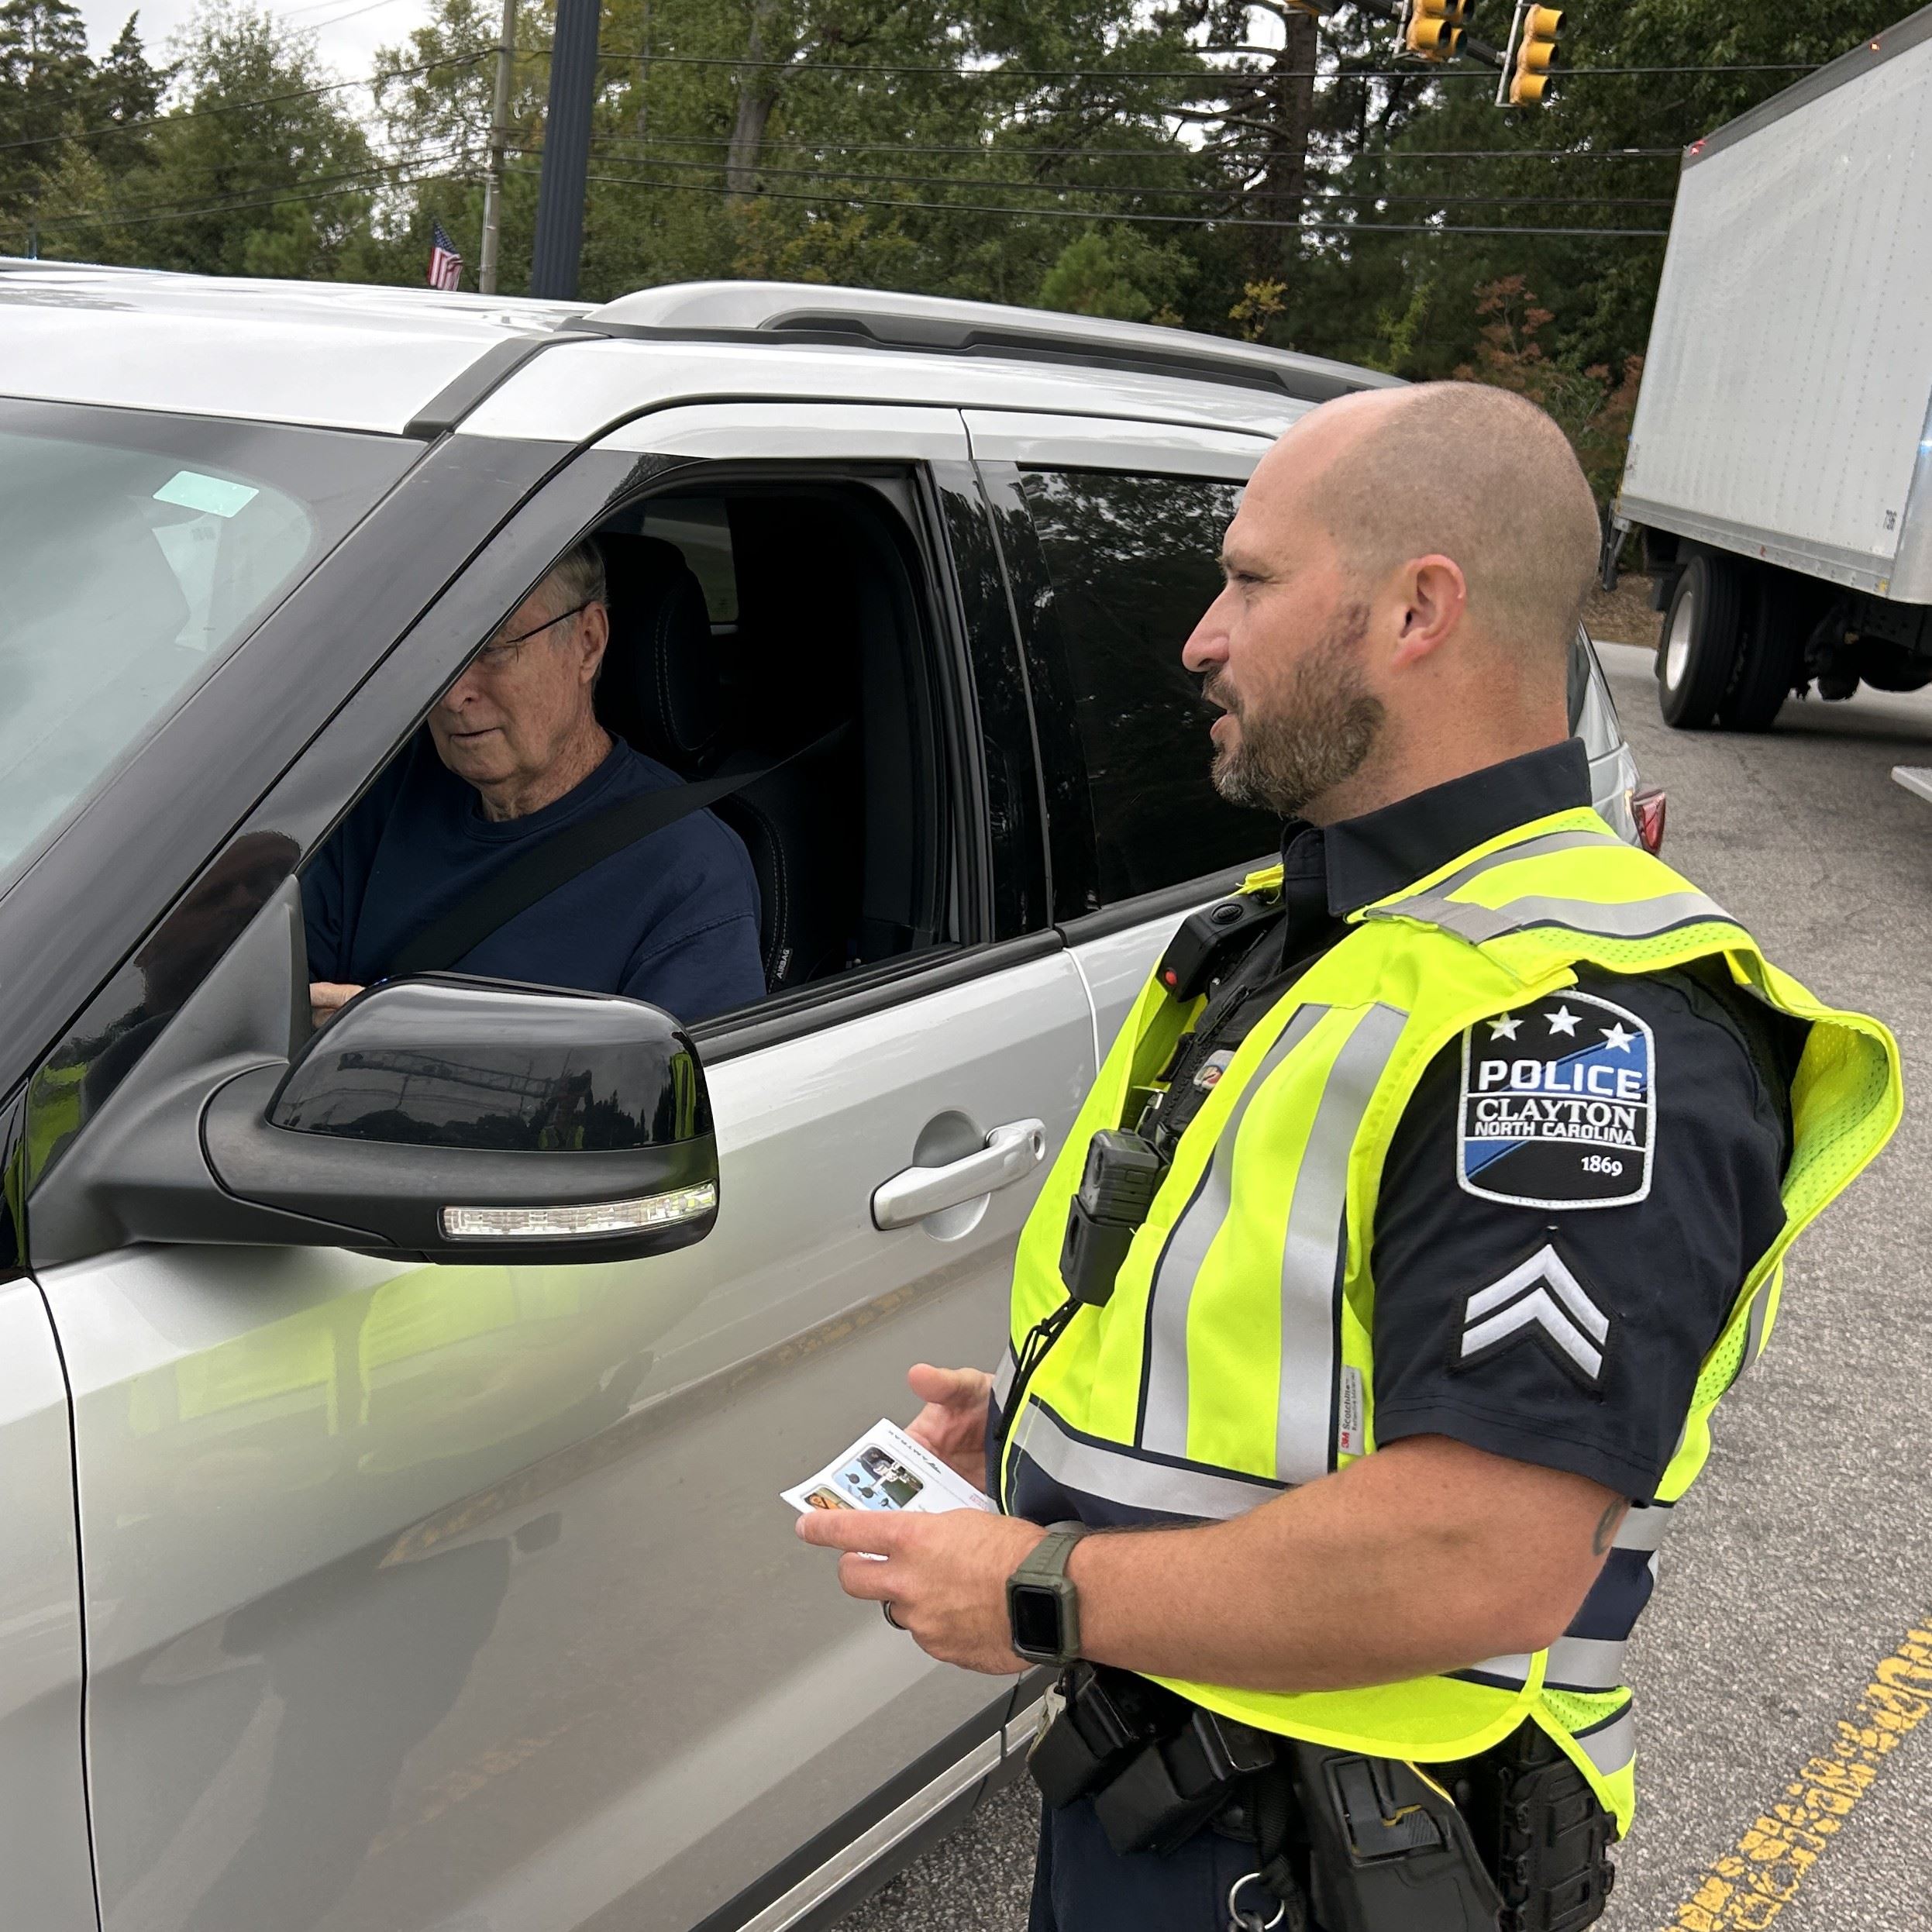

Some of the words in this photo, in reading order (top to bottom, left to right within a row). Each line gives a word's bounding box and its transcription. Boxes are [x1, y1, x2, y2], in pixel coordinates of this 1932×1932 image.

[777, 949, 790, 979] AIRBAG
[1479, 1059, 1643, 1100] POLICE
[1476, 1098, 1637, 1131] CLAYTON
[1475, 1121, 1535, 1136] NORTH
[1542, 1122, 1637, 1145] CAROLINA
[1581, 1155, 1623, 1176] 1869
[1341, 1431, 1350, 1448] 3M
